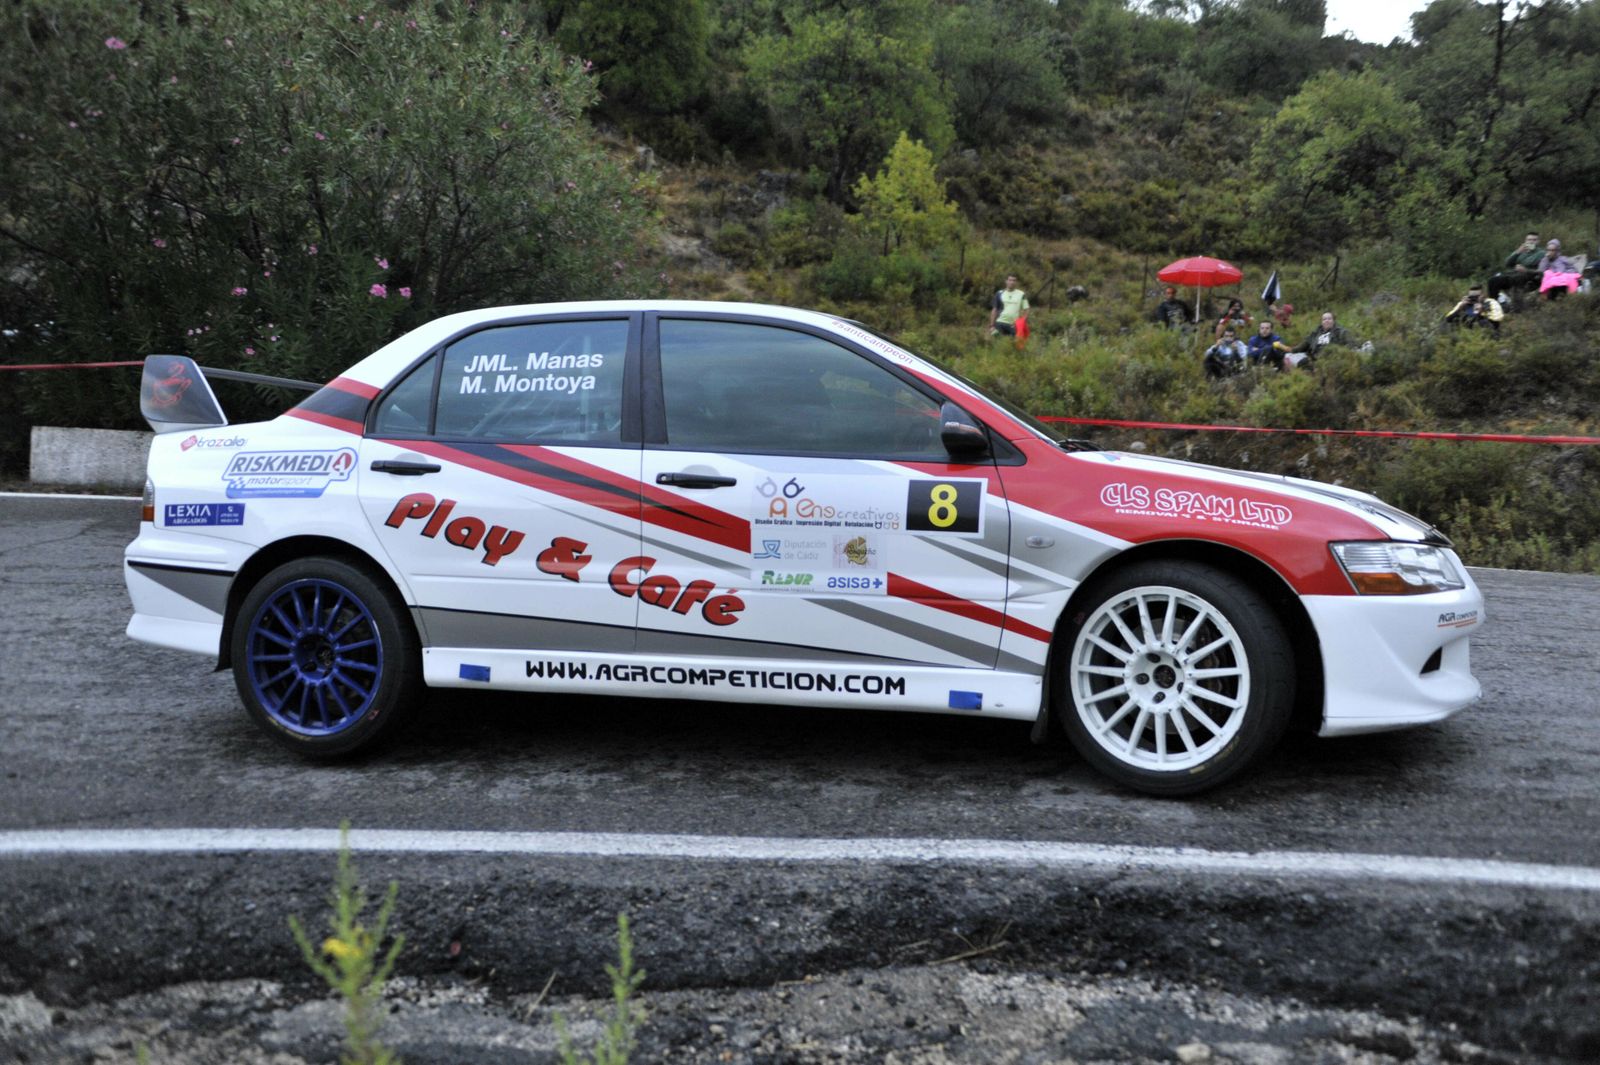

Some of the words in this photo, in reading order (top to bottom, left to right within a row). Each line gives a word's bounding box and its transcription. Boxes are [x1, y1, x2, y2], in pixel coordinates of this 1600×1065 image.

[463, 354, 519, 373] JML.
[525, 352, 603, 370] Manas
[459, 376, 487, 394] M.
[494, 374, 596, 394] Montoya
[247, 476, 313, 486] motorsport
[168, 505, 212, 517] LEXIA
[928, 483, 958, 528] 8
[1100, 483, 1150, 509] CLS
[1154, 488, 1235, 518] SPAIN
[1239, 498, 1293, 526] LTD
[1212, 517, 1280, 530] STORAGE
[384, 492, 526, 566] Play
[535, 536, 592, 582] &
[607, 556, 746, 626] Café
[784, 551, 795, 560] de
[525, 660, 906, 696] WWW.AGRCOMPETICION.COM
